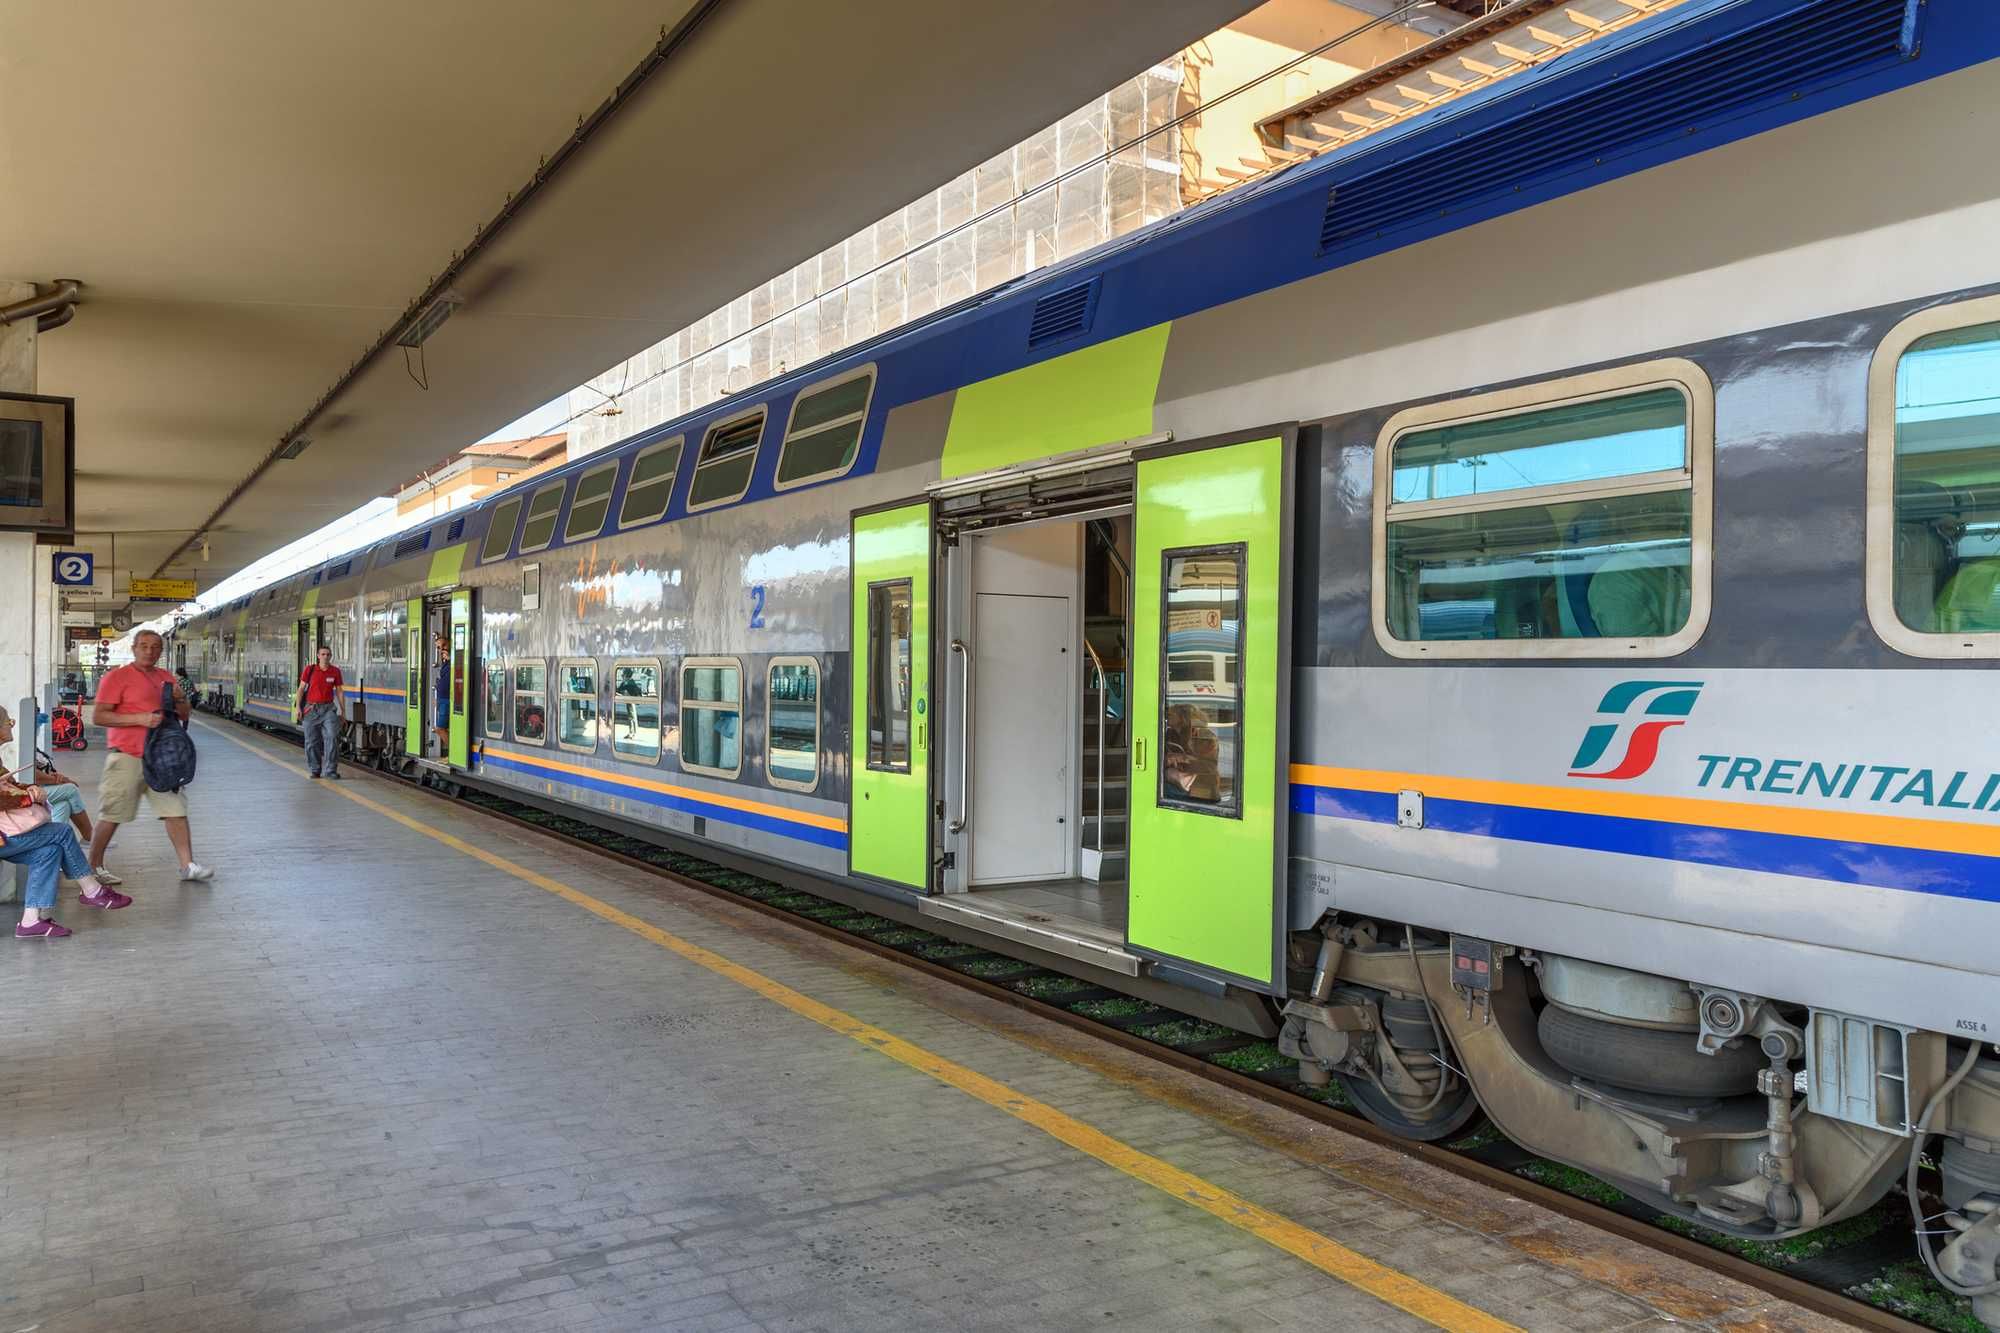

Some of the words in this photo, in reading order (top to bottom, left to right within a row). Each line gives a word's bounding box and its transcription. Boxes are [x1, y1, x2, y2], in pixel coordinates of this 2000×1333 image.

[66, 561, 82, 577] 2
[750, 585, 766, 628] 2
[1697, 754, 2000, 812] TRENITALI
[1956, 1019, 1978, 1032] ASSE
[1980, 1023, 1988, 1032] 4
